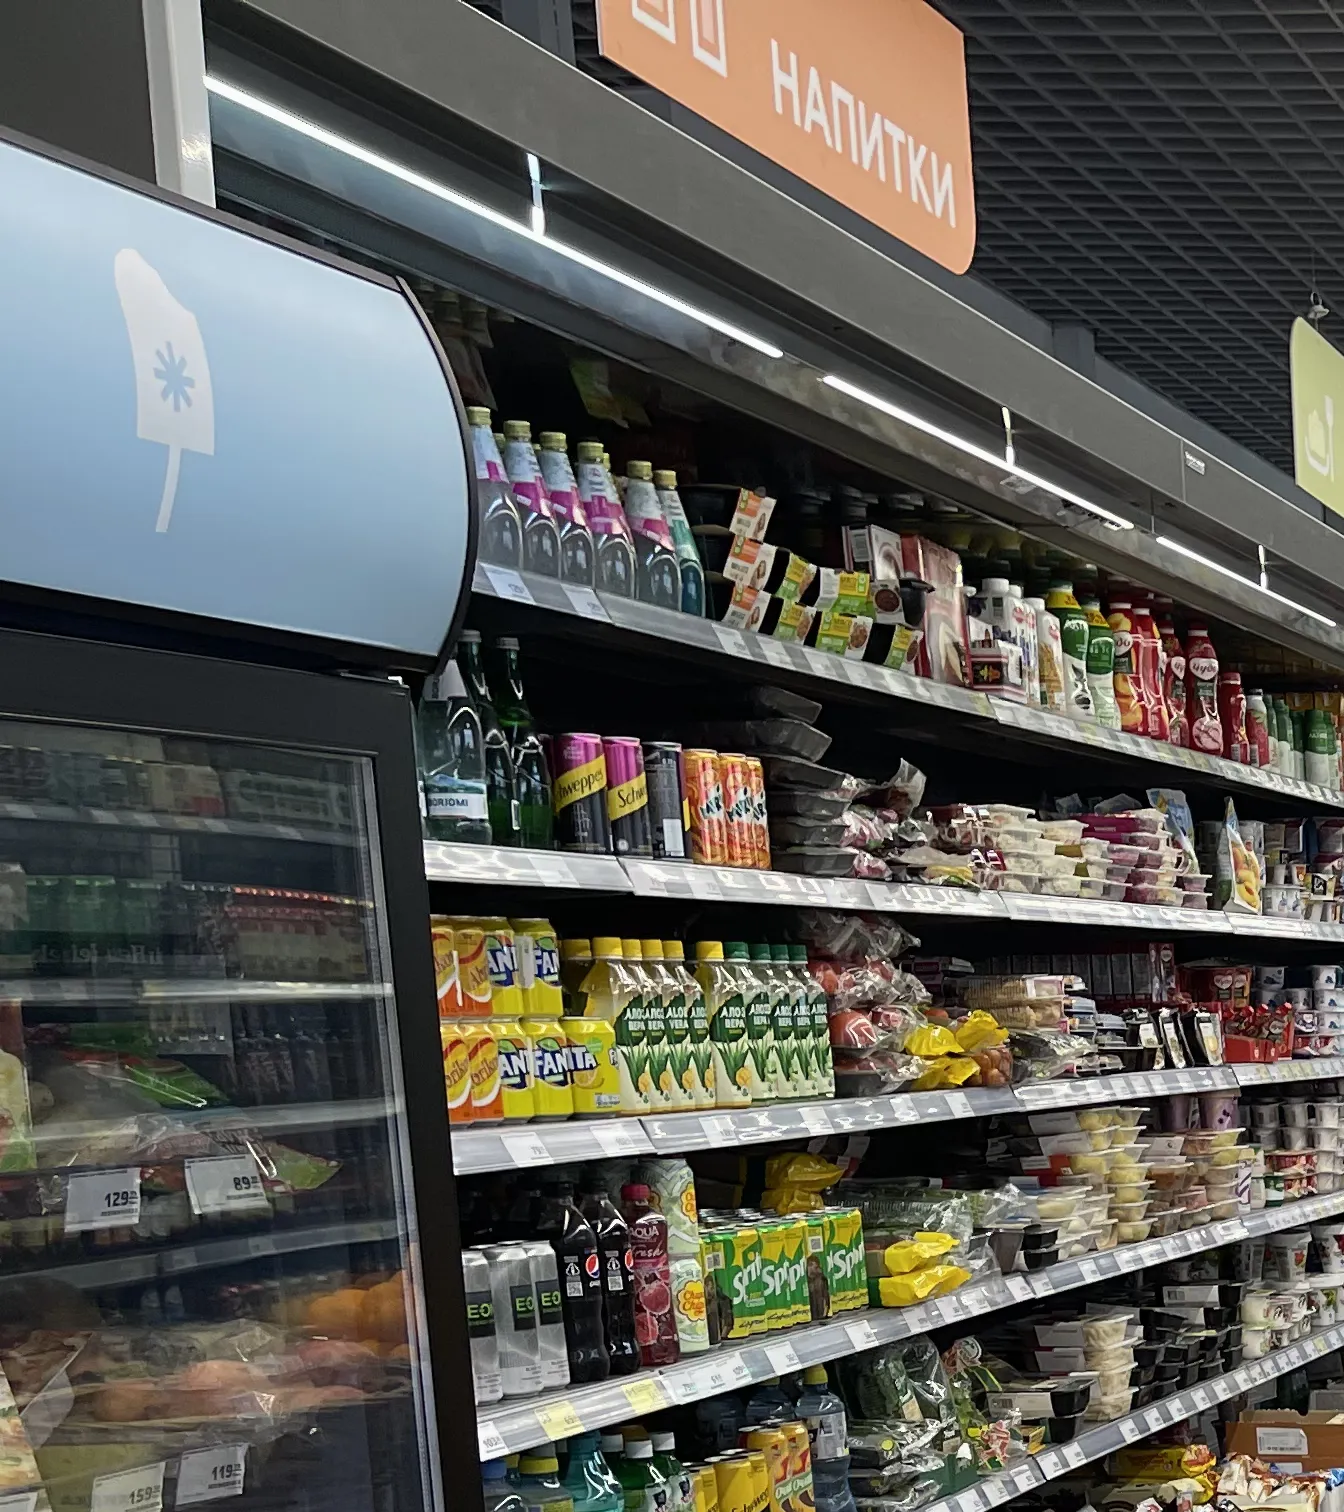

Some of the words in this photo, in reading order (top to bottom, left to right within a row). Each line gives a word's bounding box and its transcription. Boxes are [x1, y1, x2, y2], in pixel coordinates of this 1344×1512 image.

[769, 39, 957, 229] НАПИТКИ
[534, 1047, 568, 1081] FAN
[232, 1175, 252, 1191] 89
[104, 1189, 129, 1208] 129
[210, 1464, 233, 1481] 119
